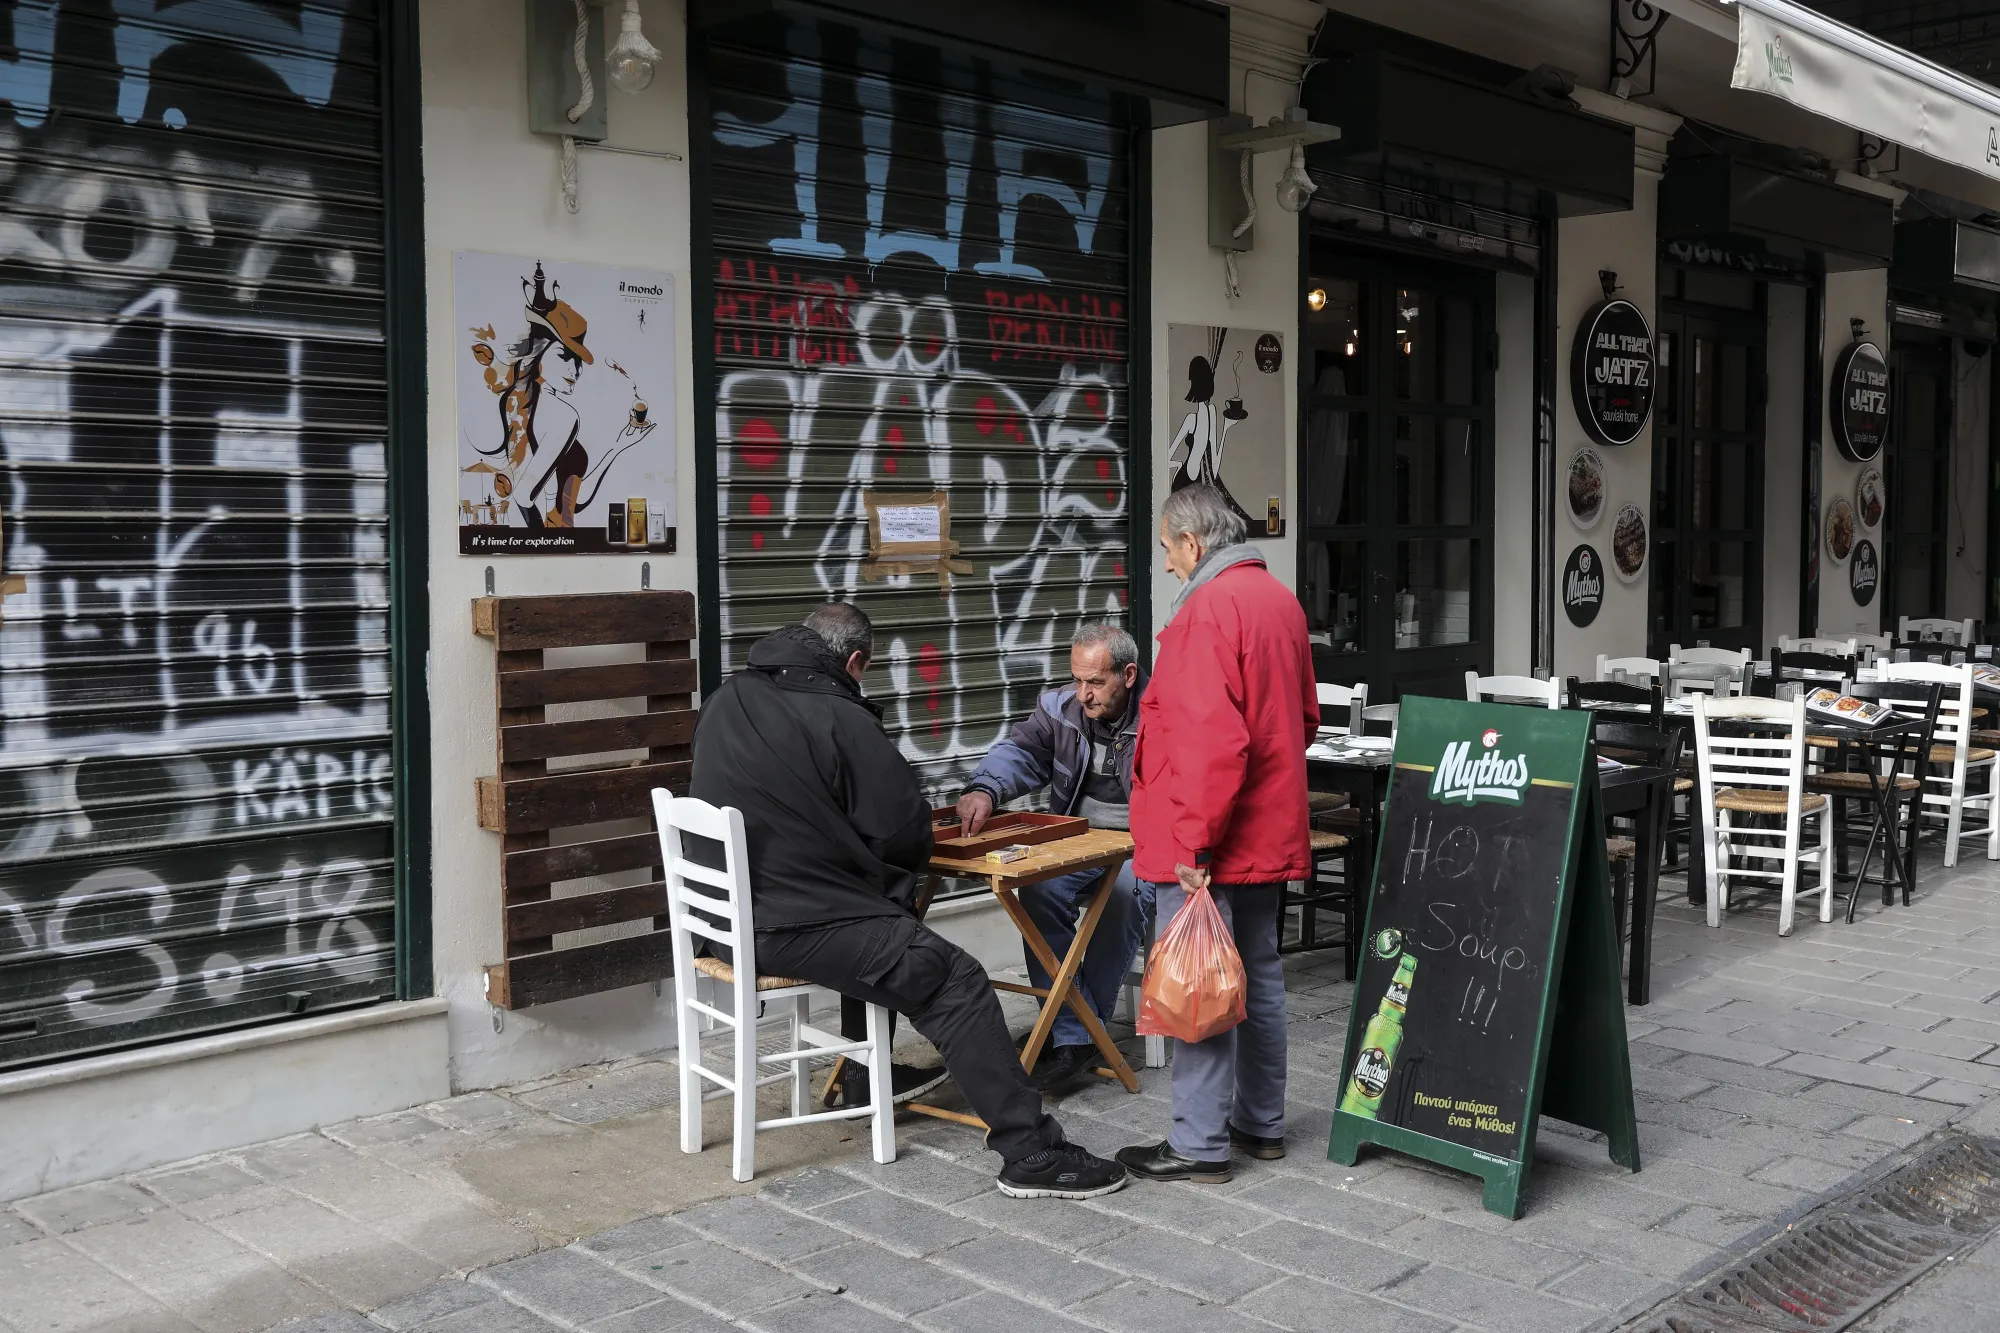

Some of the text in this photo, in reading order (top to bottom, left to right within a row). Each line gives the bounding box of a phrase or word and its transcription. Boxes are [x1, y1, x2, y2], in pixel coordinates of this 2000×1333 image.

[619, 281, 663, 296] il mondo
[1596, 333, 1649, 353] ALL THAT
[1595, 357, 1649, 387] JATZ
[1851, 368, 1867, 384] ALL
[1850, 389, 1887, 414] JATZ
[1603, 409, 1639, 423] souvlaki home
[472, 534, 575, 548] It's time for exploration
[1853, 561, 1876, 589] Mythos
[1566, 570, 1600, 605] Mythos
[1433, 741, 1528, 800] Mythos
[1421, 903, 1526, 990] Soup
[1386, 984, 1408, 1003] Mythos
[1354, 1053, 1389, 1084] Mythos
[1414, 1092, 1498, 1116] Παντού υπάρχει
[1448, 1113, 1516, 1135] ένας Μύθος!
